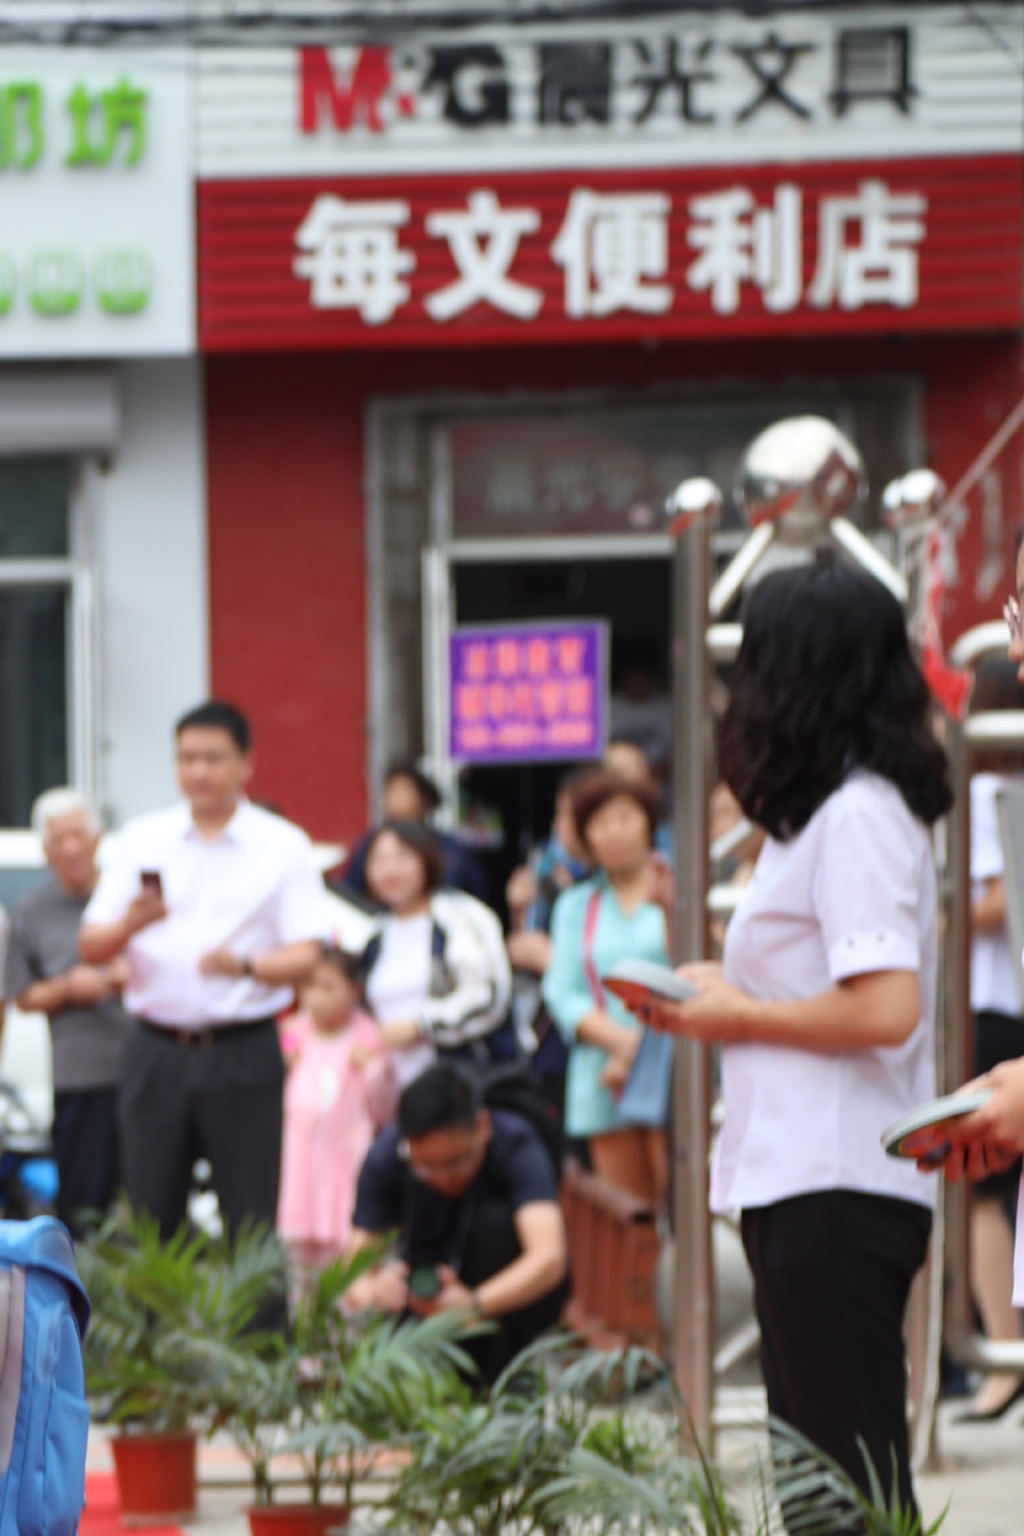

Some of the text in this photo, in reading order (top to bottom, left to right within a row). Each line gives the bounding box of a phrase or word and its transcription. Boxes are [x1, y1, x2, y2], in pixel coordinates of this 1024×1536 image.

[537, 25, 918, 127] 晨光文具
[294, 179, 927, 325] 每文便利店
